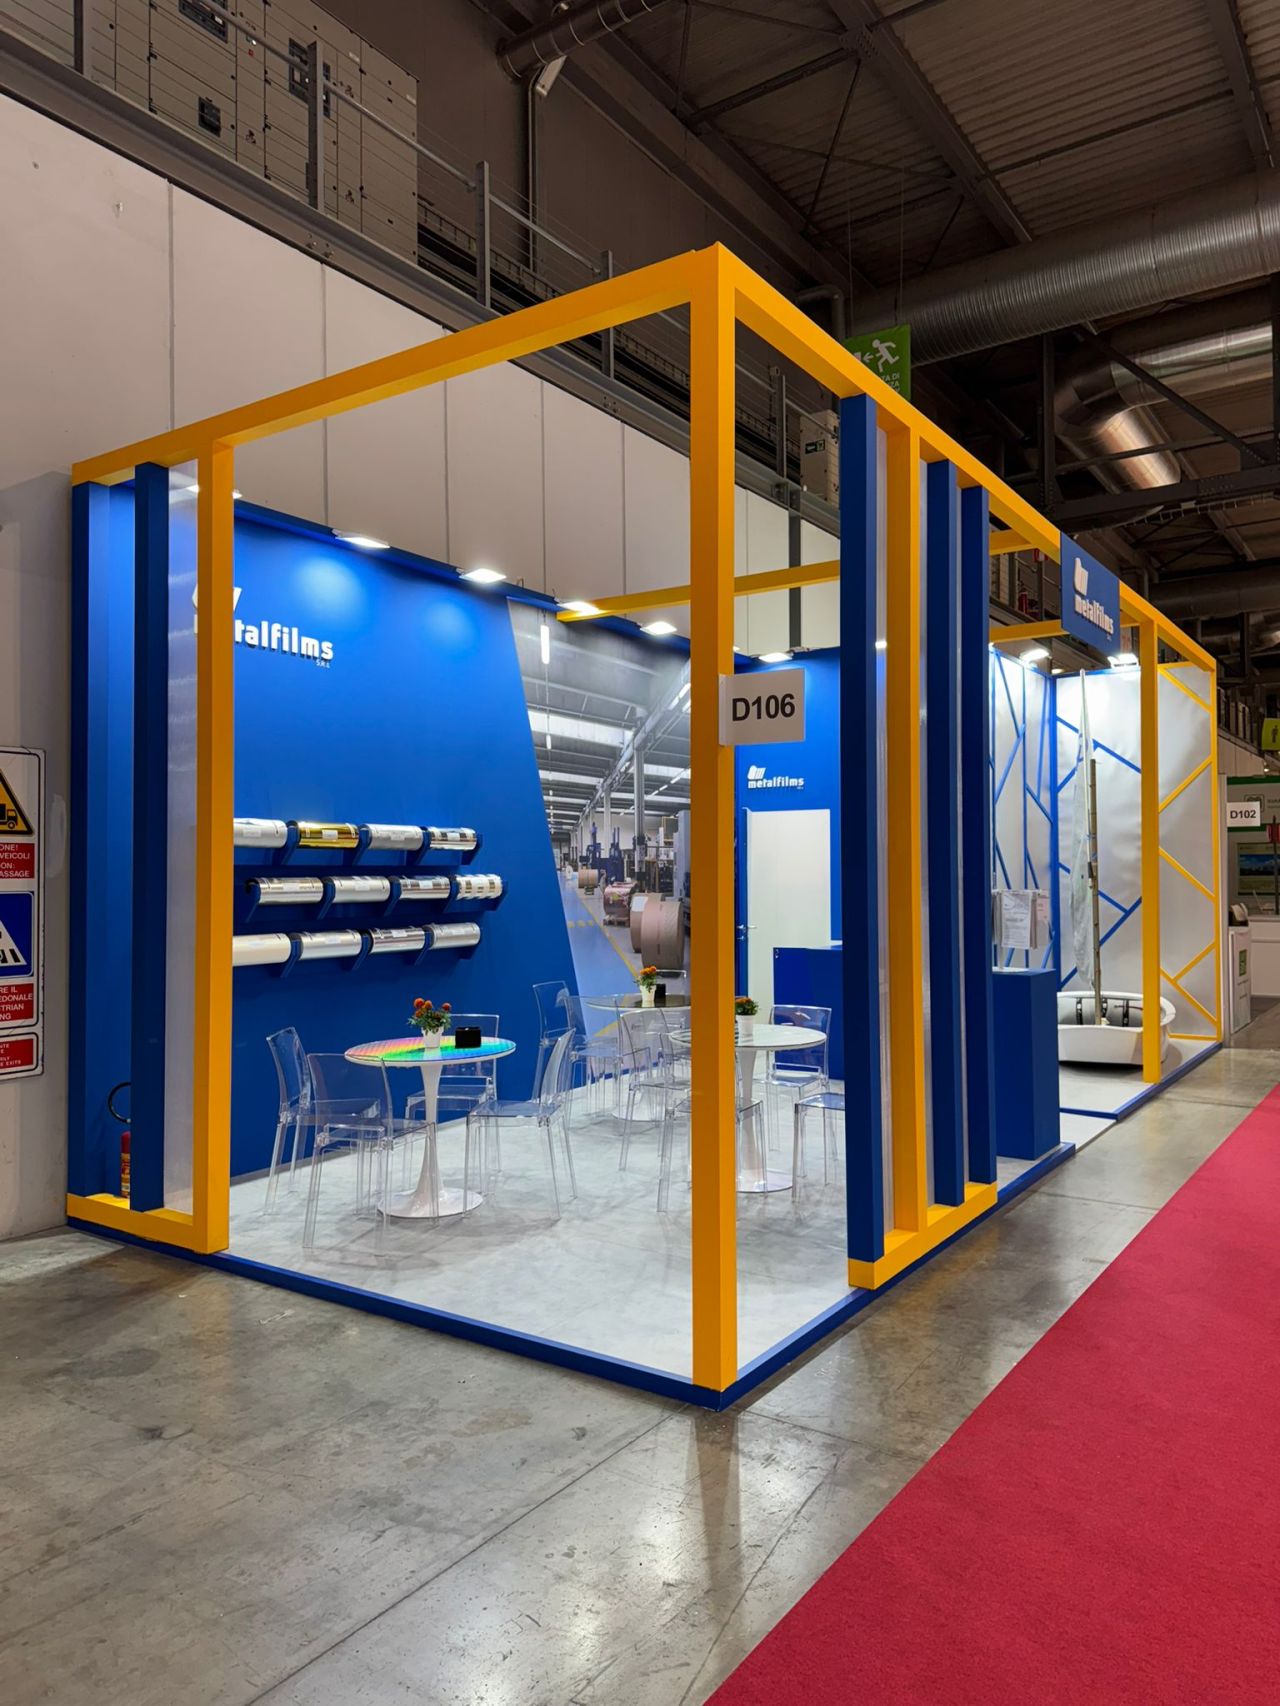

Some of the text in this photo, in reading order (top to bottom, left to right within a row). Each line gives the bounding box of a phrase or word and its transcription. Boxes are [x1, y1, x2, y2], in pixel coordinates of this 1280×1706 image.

[1075, 594, 1114, 634] metalfilms
[194, 614, 334, 660] talfilms
[732, 693, 796, 722] D106
[747, 776, 805, 789] metalfilms
[1230, 810, 1257, 819] D102
